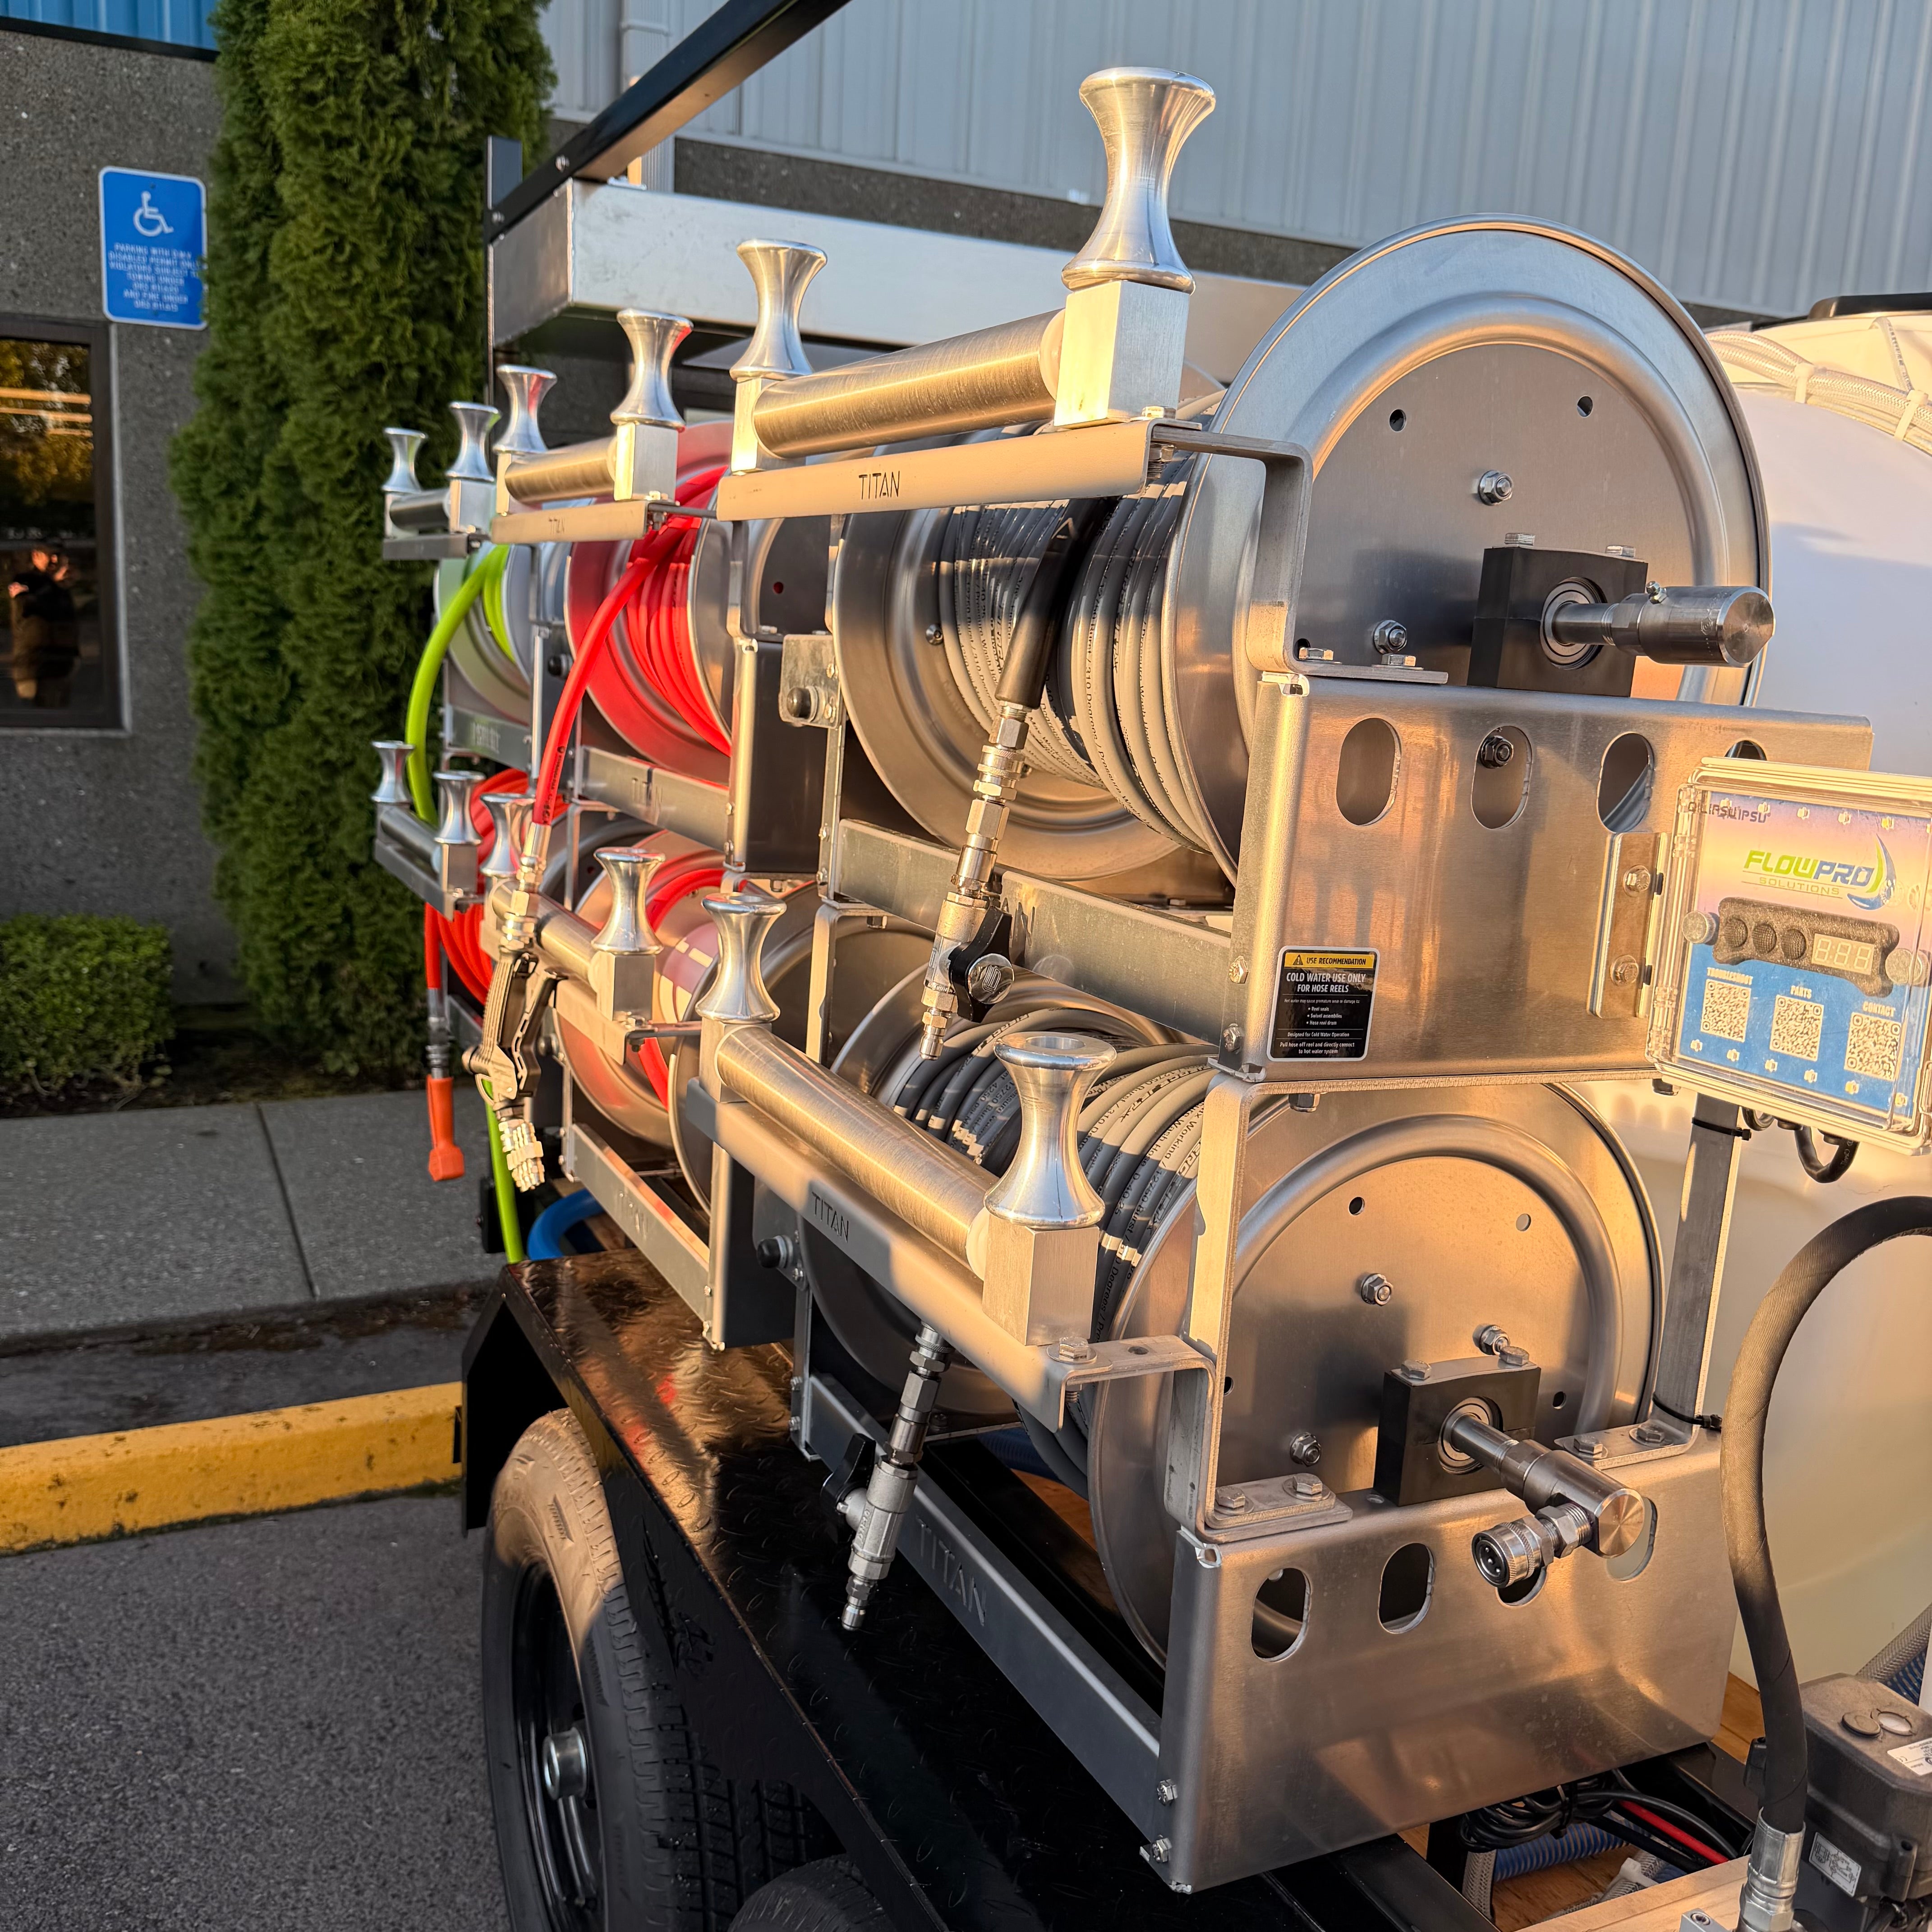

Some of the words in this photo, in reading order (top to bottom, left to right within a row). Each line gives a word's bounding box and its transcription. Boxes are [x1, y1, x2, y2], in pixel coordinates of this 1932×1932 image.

[108, 251, 147, 262] DISABLED
[114, 243, 148, 253] PARKING
[859, 470, 900, 500] TITAN
[981, 639, 992, 666] Wash
[1098, 751, 1122, 795] Pressure
[1744, 850, 1874, 887] FLOWPRO
[1759, 877, 1840, 895] SOLUTIONS
[1287, 972, 1304, 982] COLD
[1307, 973, 1330, 982] WATER
[1332, 973, 1346, 983] USE
[1348, 974, 1366, 983] ONLY
[1707, 967, 1753, 985] TROUBLESHOOT
[1297, 984, 1310, 992] FOR
[1311, 984, 1328, 993] HOSE
[1790, 985, 1812, 998] PARTS
[1863, 1001, 1895, 1017] CONTACT
[980, 1083, 998, 1102] 4250
[1098, 1109, 1114, 1125] 310
[1159, 1119, 1184, 1141] Wash
[1164, 1121, 1197, 1159] Working
[1141, 1144, 1161, 1167] Hose
[1142, 1170, 1163, 1203] 12750
[812, 1191, 849, 1243] TITAN
[1127, 1204, 1145, 1234] Burst
[1101, 1266, 1119, 1311] Degrees
[916, 1515, 987, 1626] TITAN
